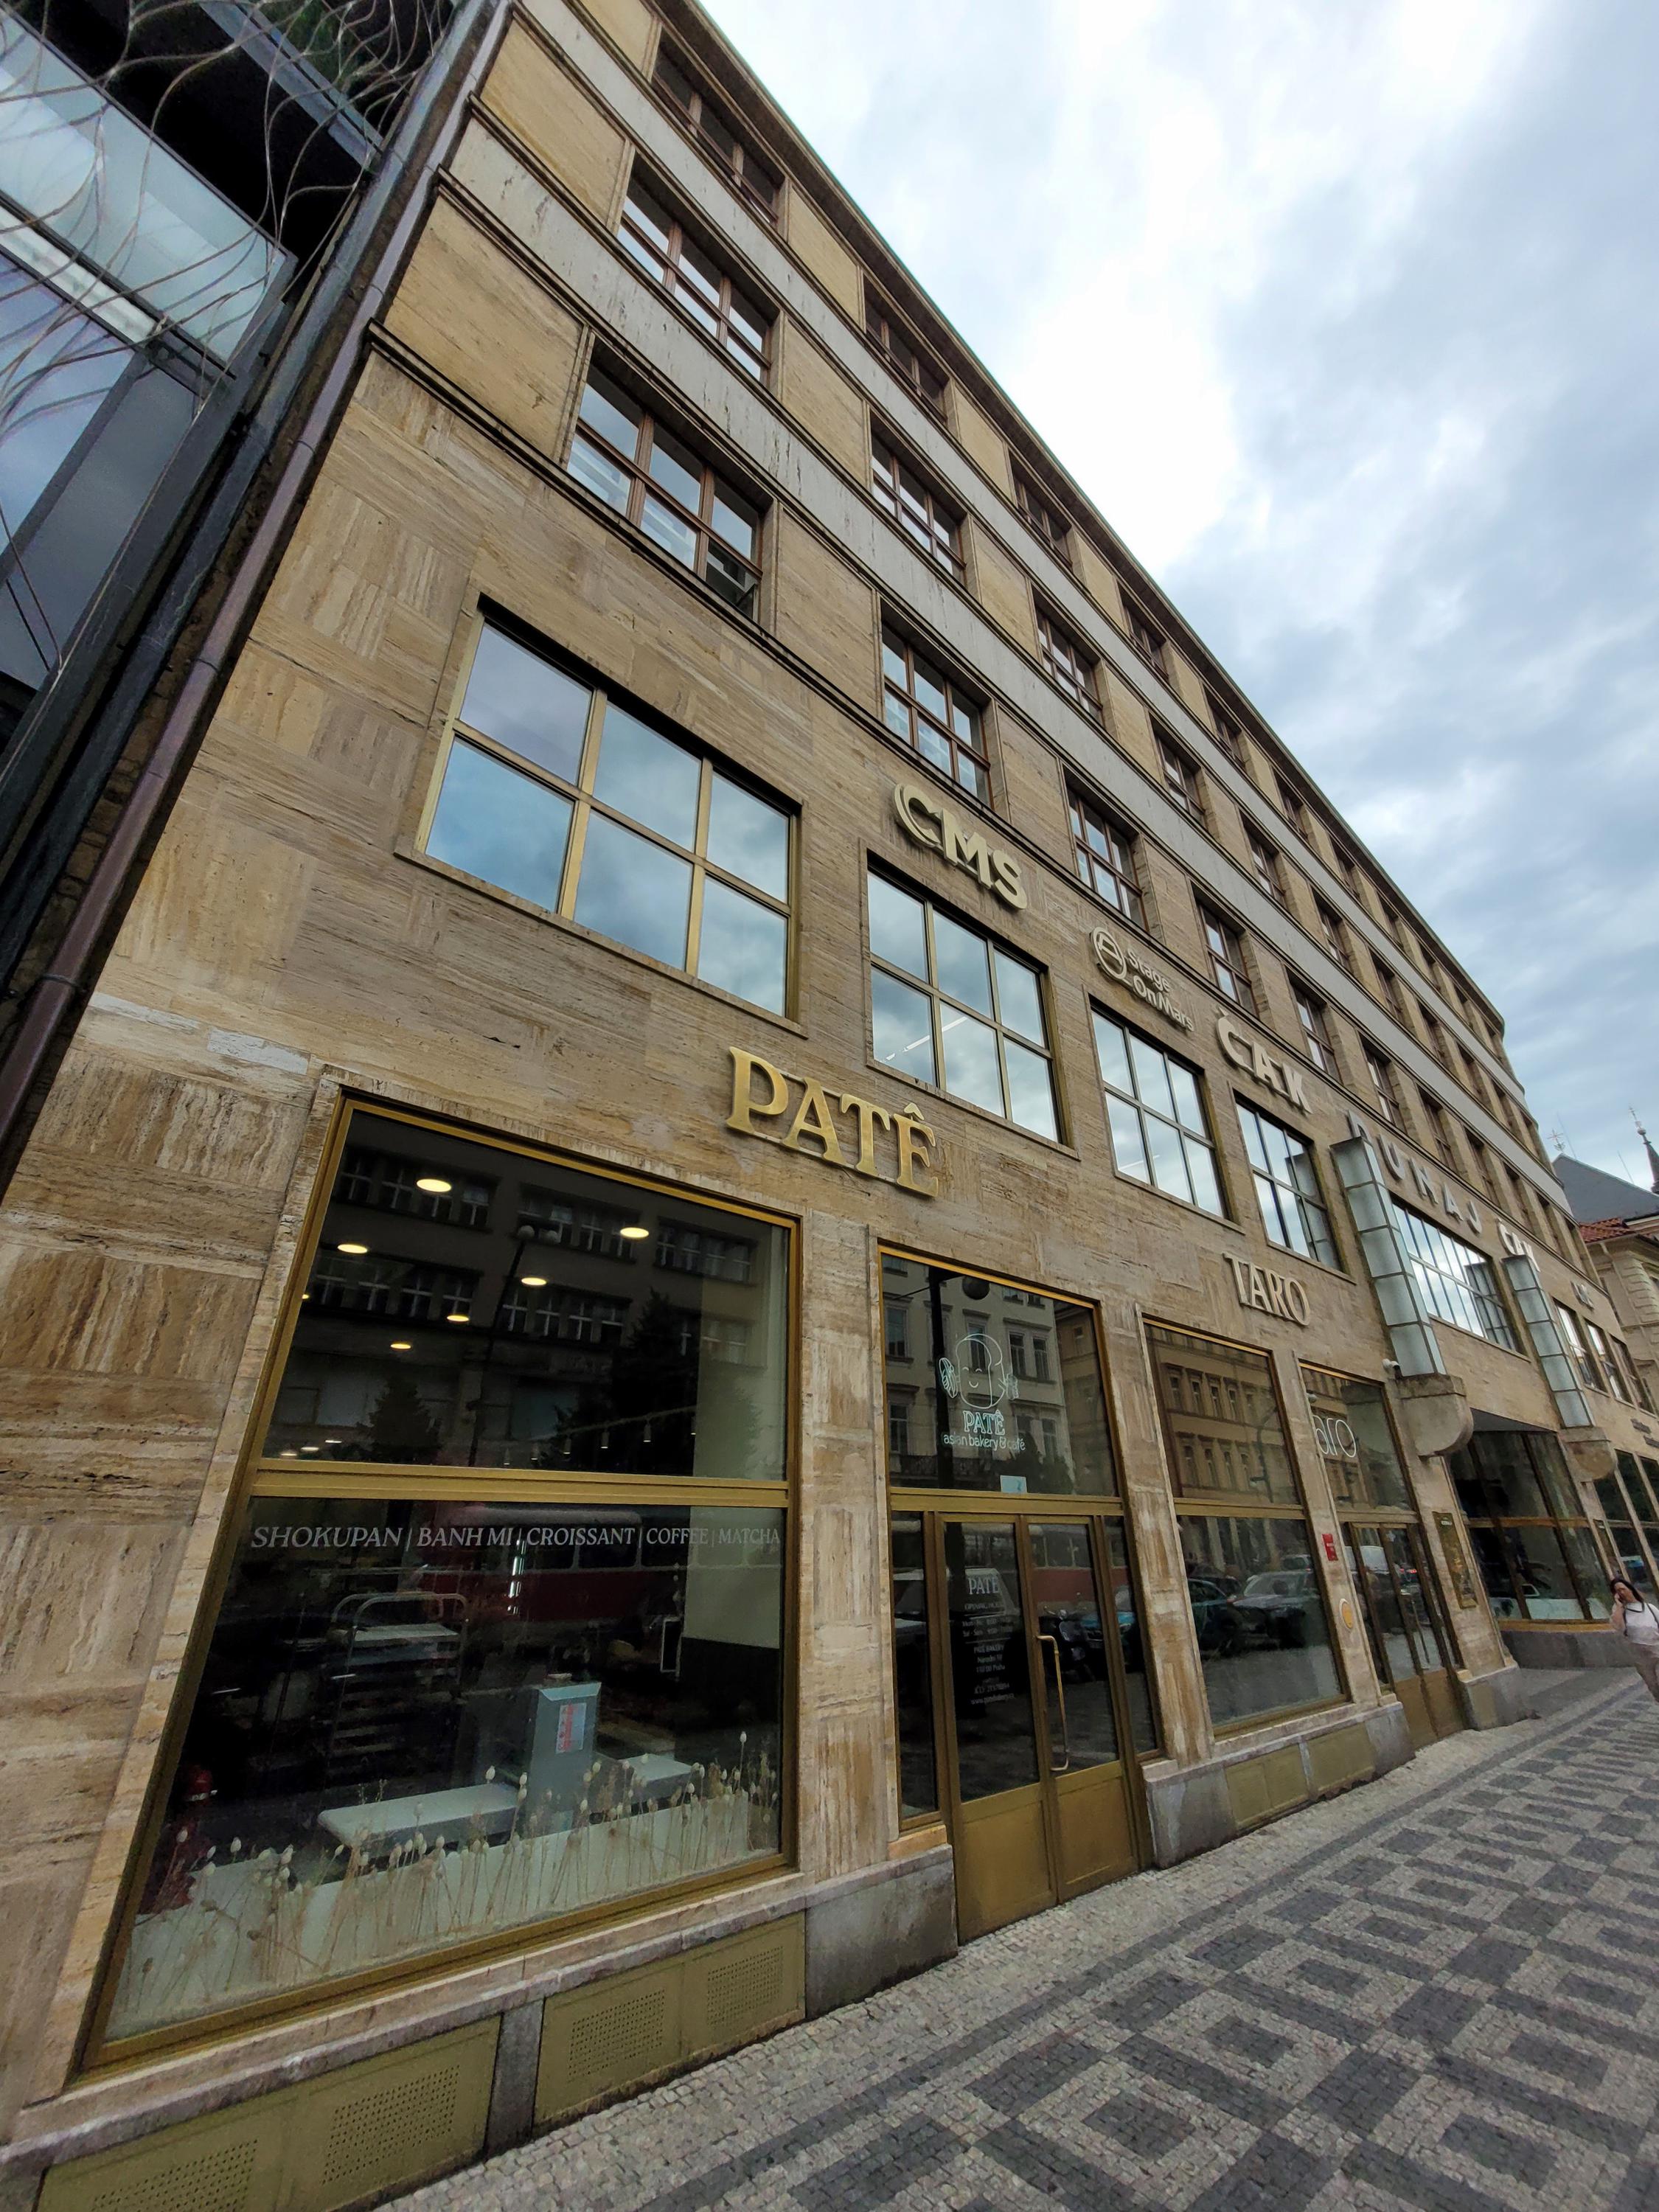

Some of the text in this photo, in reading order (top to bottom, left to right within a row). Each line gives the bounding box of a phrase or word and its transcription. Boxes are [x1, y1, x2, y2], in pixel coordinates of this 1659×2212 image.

[894, 782, 1027, 910] CMS
[1127, 948, 1172, 993] Stage
[1216, 1004, 1313, 1115] ČAK
[726, 1046, 939, 1198] PATÊ
[1222, 1251, 1311, 1326] TARO
[942, 1431, 969, 1446] asian
[968, 1433, 999, 1452] bakery
[1006, 1438, 1026, 1453] café
[962, 1409, 1006, 1436] PATÊ
[251, 1526, 782, 1548] SHOKUPAN BANH MI CROISSANT COFFEE MATCHA
